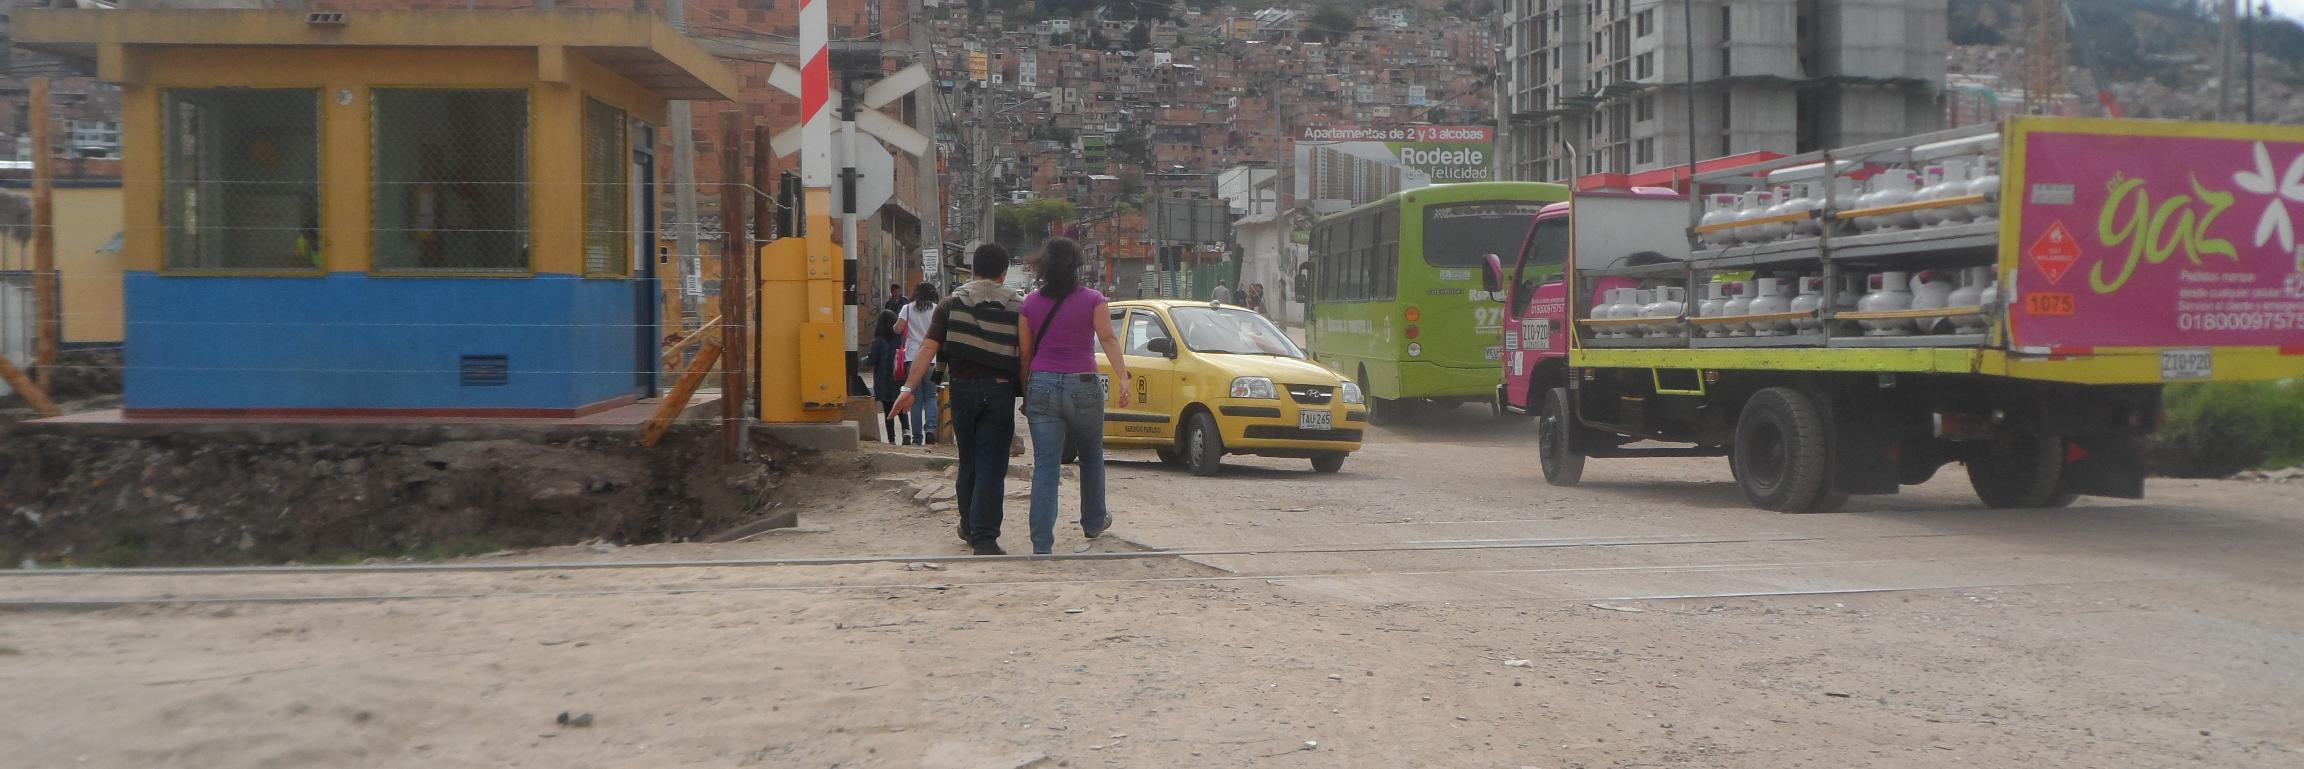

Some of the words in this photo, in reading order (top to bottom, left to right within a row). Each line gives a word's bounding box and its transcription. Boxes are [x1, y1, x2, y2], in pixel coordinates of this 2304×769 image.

[1304, 127, 1386, 142] Apartamentos
[1389, 128, 1404, 140] de
[1406, 128, 1415, 140] 2
[1418, 130, 1425, 142] y
[1429, 128, 1436, 140] 3
[1439, 128, 1484, 140] alcobas
[1407, 167, 1423, 179] de
[1431, 166, 1487, 179] felicidad
[2089, 169, 2239, 294] gaz
[2031, 296, 2072, 312] 1075
